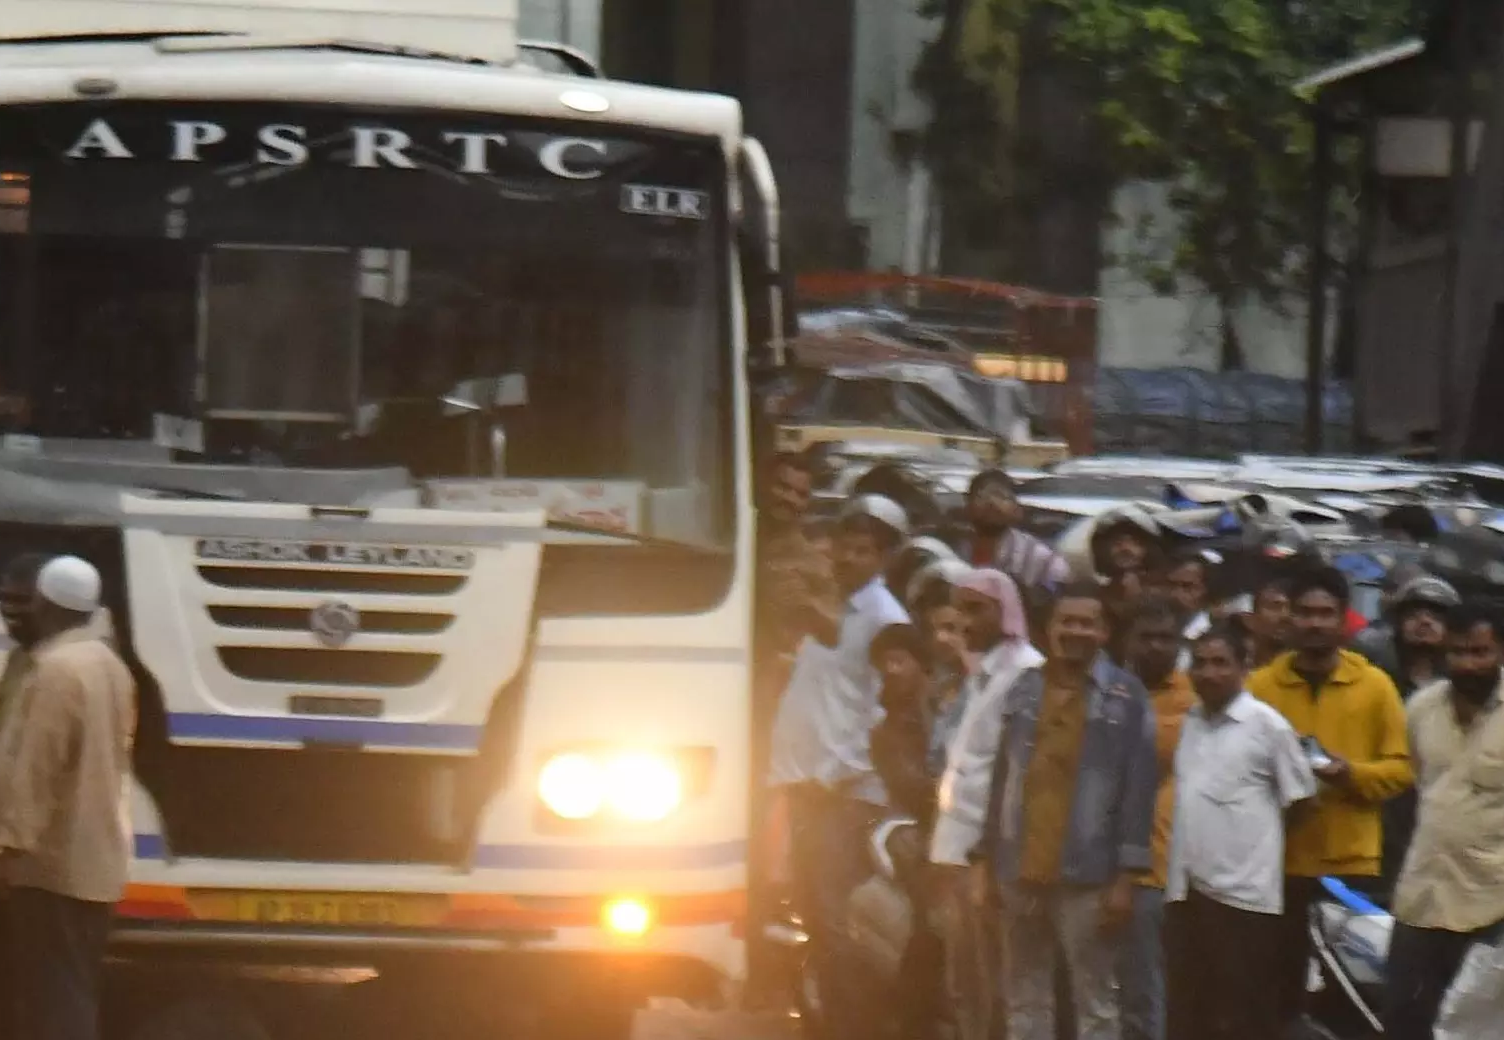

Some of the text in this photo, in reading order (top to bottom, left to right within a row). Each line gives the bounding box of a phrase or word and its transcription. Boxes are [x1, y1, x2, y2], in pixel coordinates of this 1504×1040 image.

[67, 119, 609, 180] APSRTC
[201, 541, 471, 568] ASHOK LEYLAND
